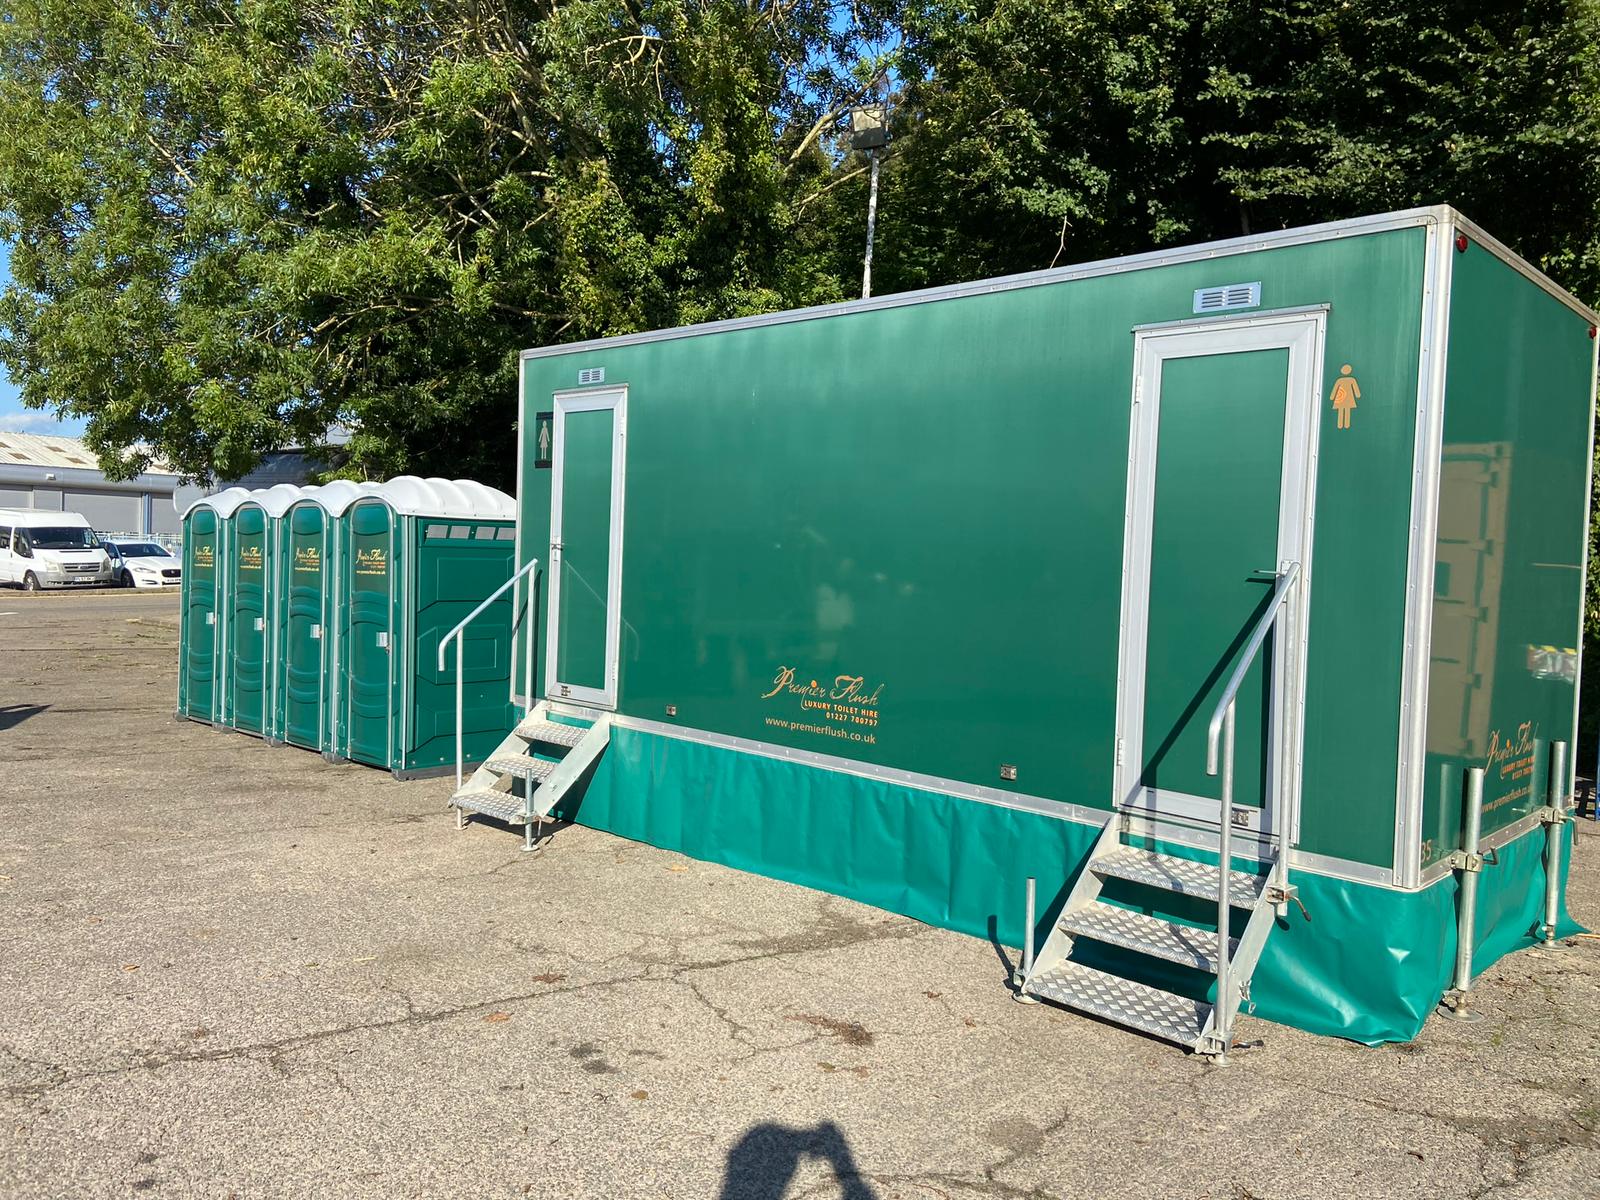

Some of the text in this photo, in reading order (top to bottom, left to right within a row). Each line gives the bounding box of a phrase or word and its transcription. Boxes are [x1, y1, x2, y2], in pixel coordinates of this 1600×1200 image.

[761, 666, 885, 710] Premier Flush
[804, 700, 878, 718] LUXURY TOILET HIRE
[826, 712, 848, 721] 01227
[765, 717, 876, 744] www.premierflush.co.uk
